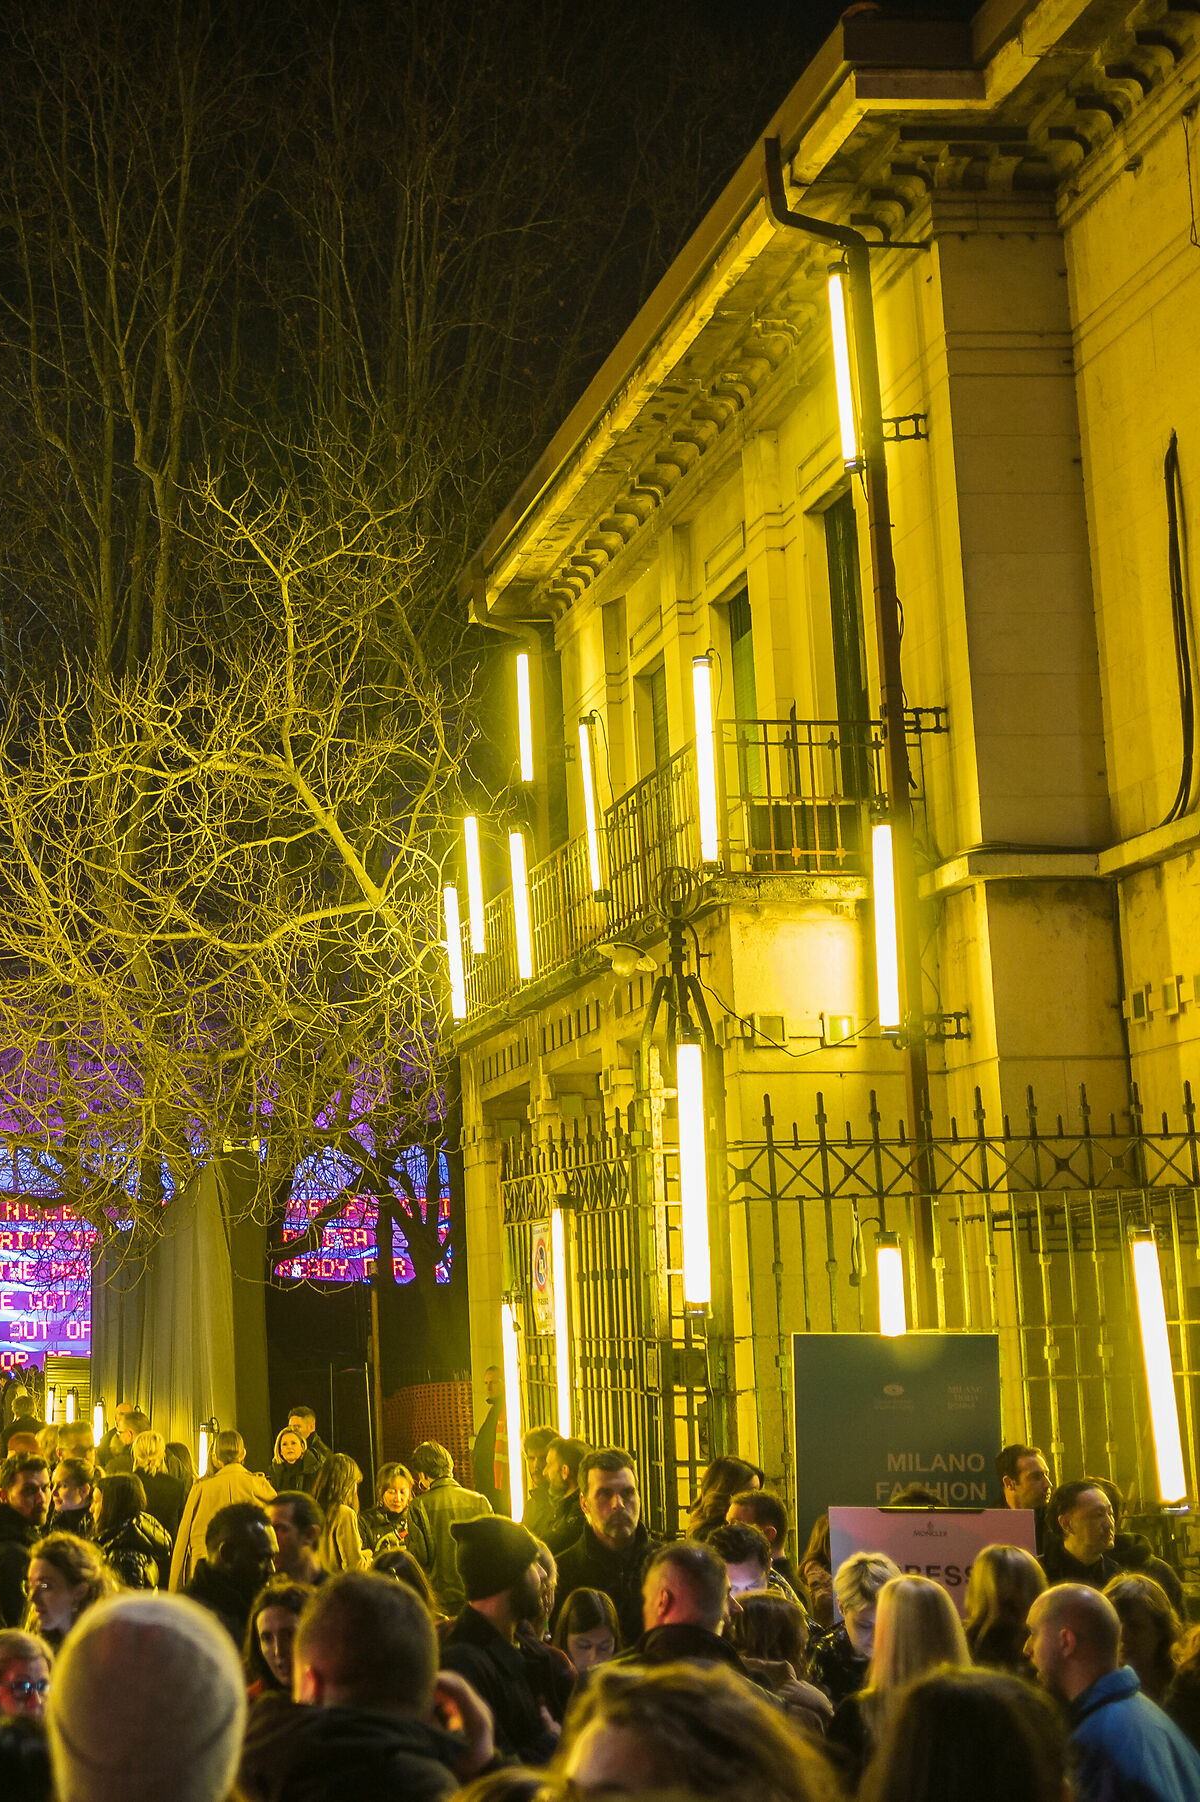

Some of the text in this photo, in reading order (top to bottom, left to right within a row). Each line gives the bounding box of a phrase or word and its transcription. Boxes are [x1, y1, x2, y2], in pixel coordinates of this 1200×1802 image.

[363, 1257, 406, 1277] FR
[28, 1290, 71, 1310] GOT
[886, 1453, 986, 1473] MILANO
